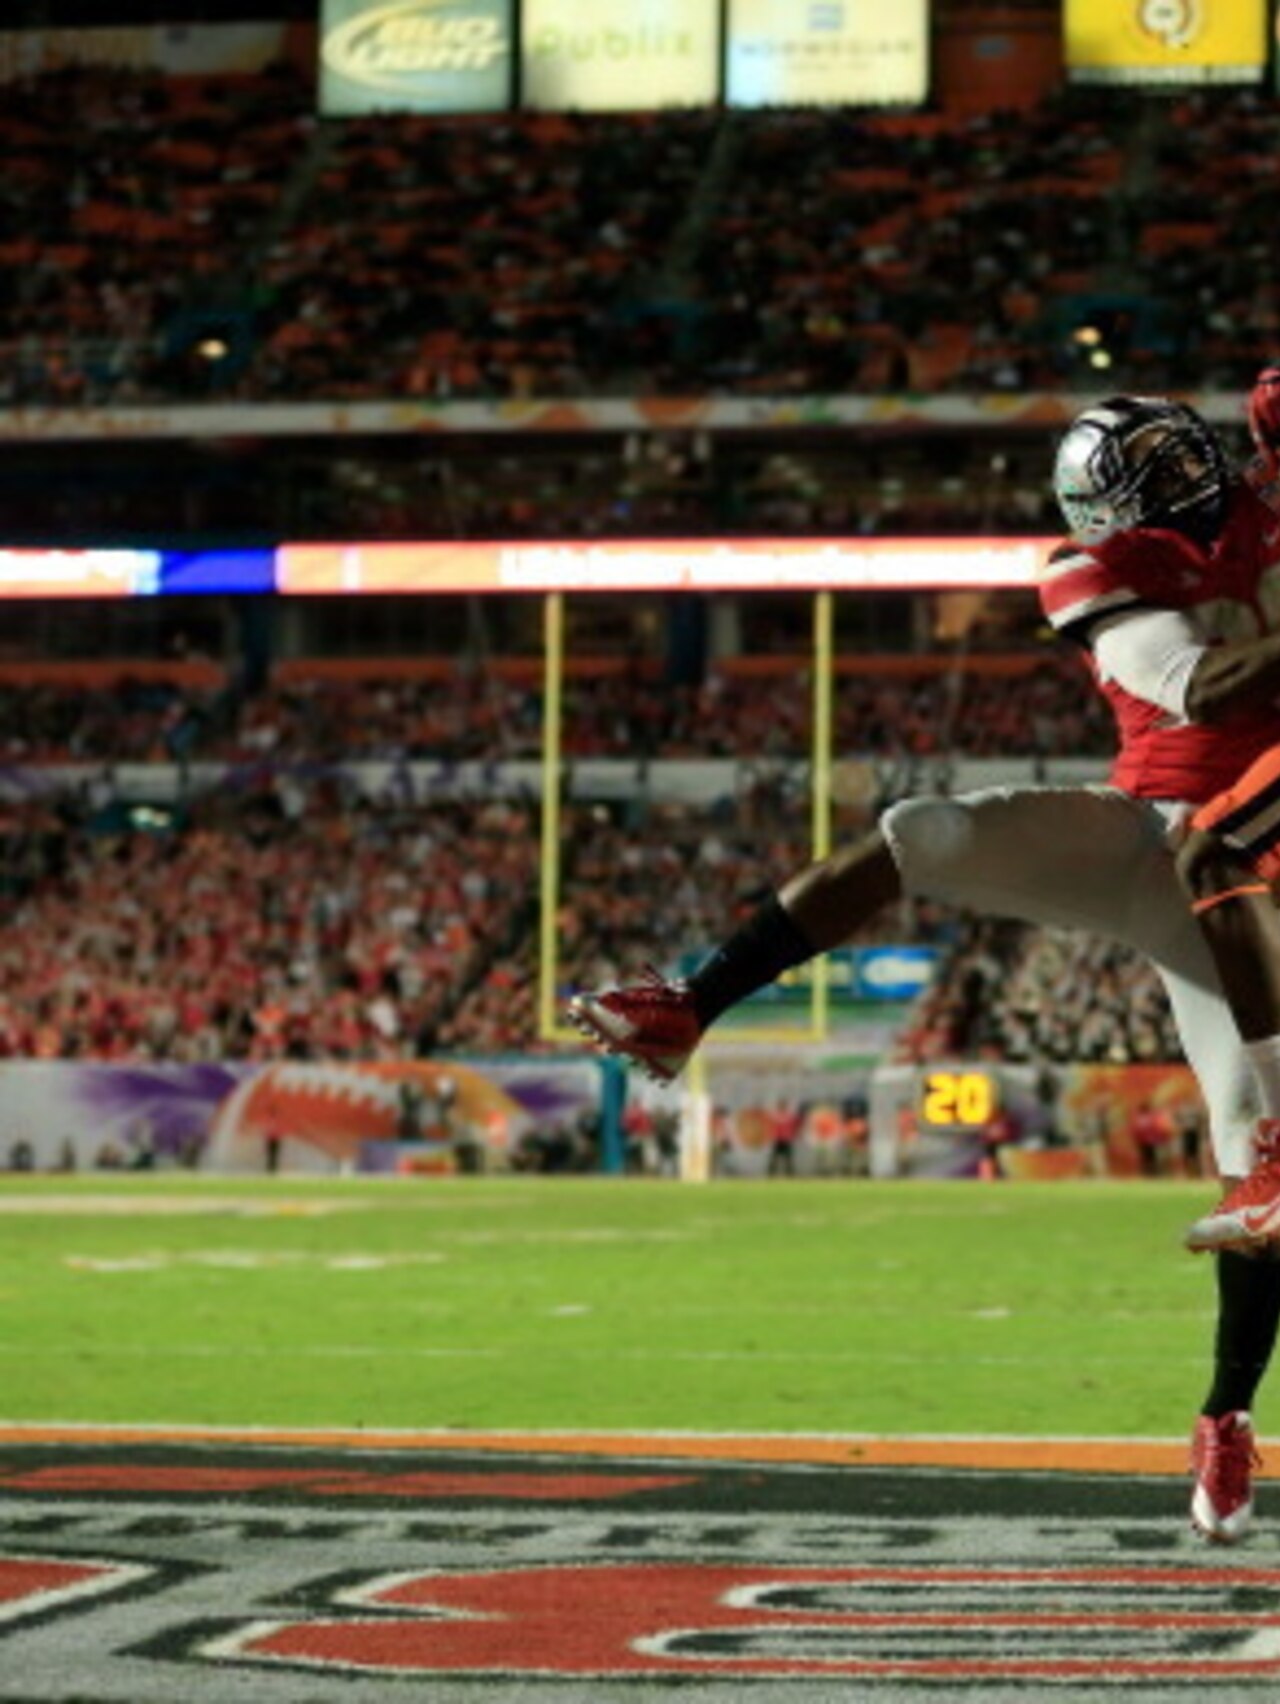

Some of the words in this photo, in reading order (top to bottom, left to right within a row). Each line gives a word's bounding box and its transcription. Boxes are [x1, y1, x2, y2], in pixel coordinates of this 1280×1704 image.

[381, 15, 498, 46] BUD
[534, 22, 693, 60] Publix
[350, 38, 508, 71] LIGHT
[922, 1072, 992, 1126] 20
